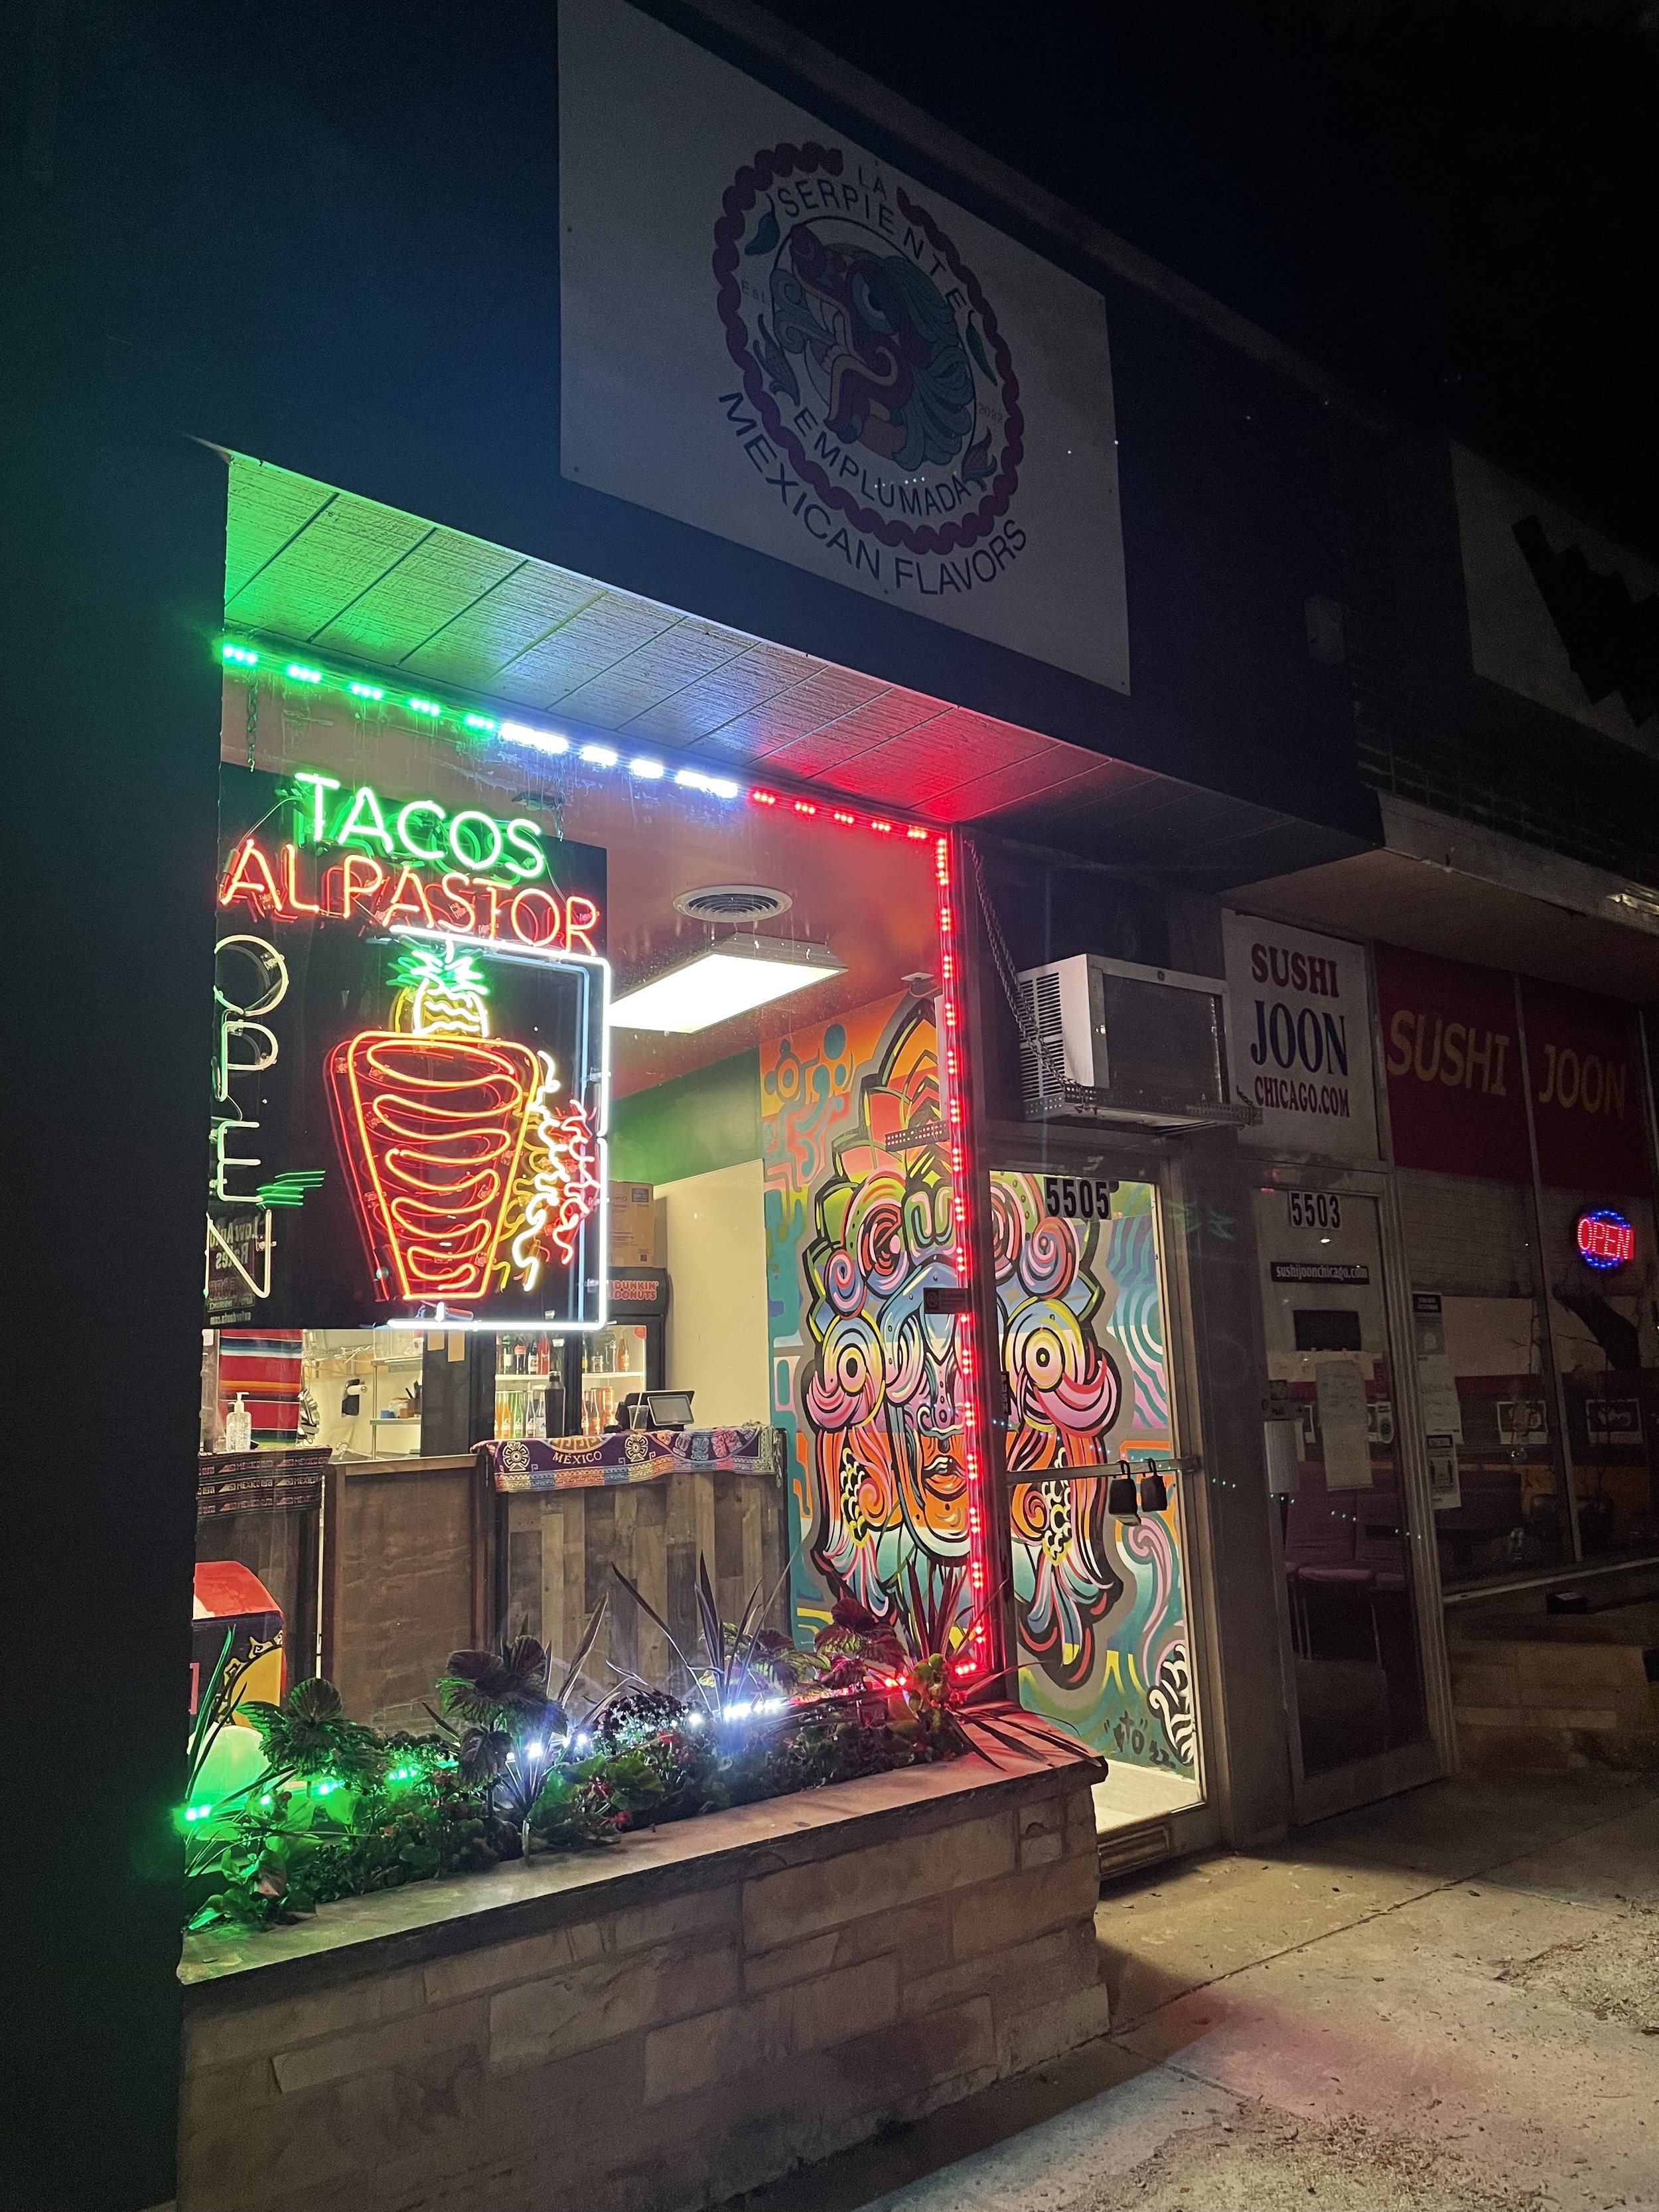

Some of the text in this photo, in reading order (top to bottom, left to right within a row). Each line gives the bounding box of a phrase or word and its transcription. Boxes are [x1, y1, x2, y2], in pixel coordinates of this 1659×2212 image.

[859, 164, 887, 196] LA
[777, 178, 968, 313] SERPIENTE
[794, 407, 970, 516] EMPLUMADA
[718, 392, 1027, 596] MEXICAN FLAVORS
[294, 773, 543, 878] TACOS
[220, 839, 597, 956] AL PASTOR
[1251, 942, 1340, 998] SUSHI
[1250, 999, 1348, 1076] JOON
[1385, 1009, 1626, 1120] SUSHI JOON
[205, 934, 289, 1298] OPEN
[1254, 1075, 1350, 1118] CHICAGO.COM
[1046, 1177, 1110, 1219] 5505
[1291, 1193, 1340, 1228] 5503
[1577, 1218, 1630, 1260] OPEN
[613, 1280, 660, 1291] DUNKIN'
[613, 1290, 658, 1301] DONUTS
[1276, 1264, 1368, 1280] sushijoonchicago.com
